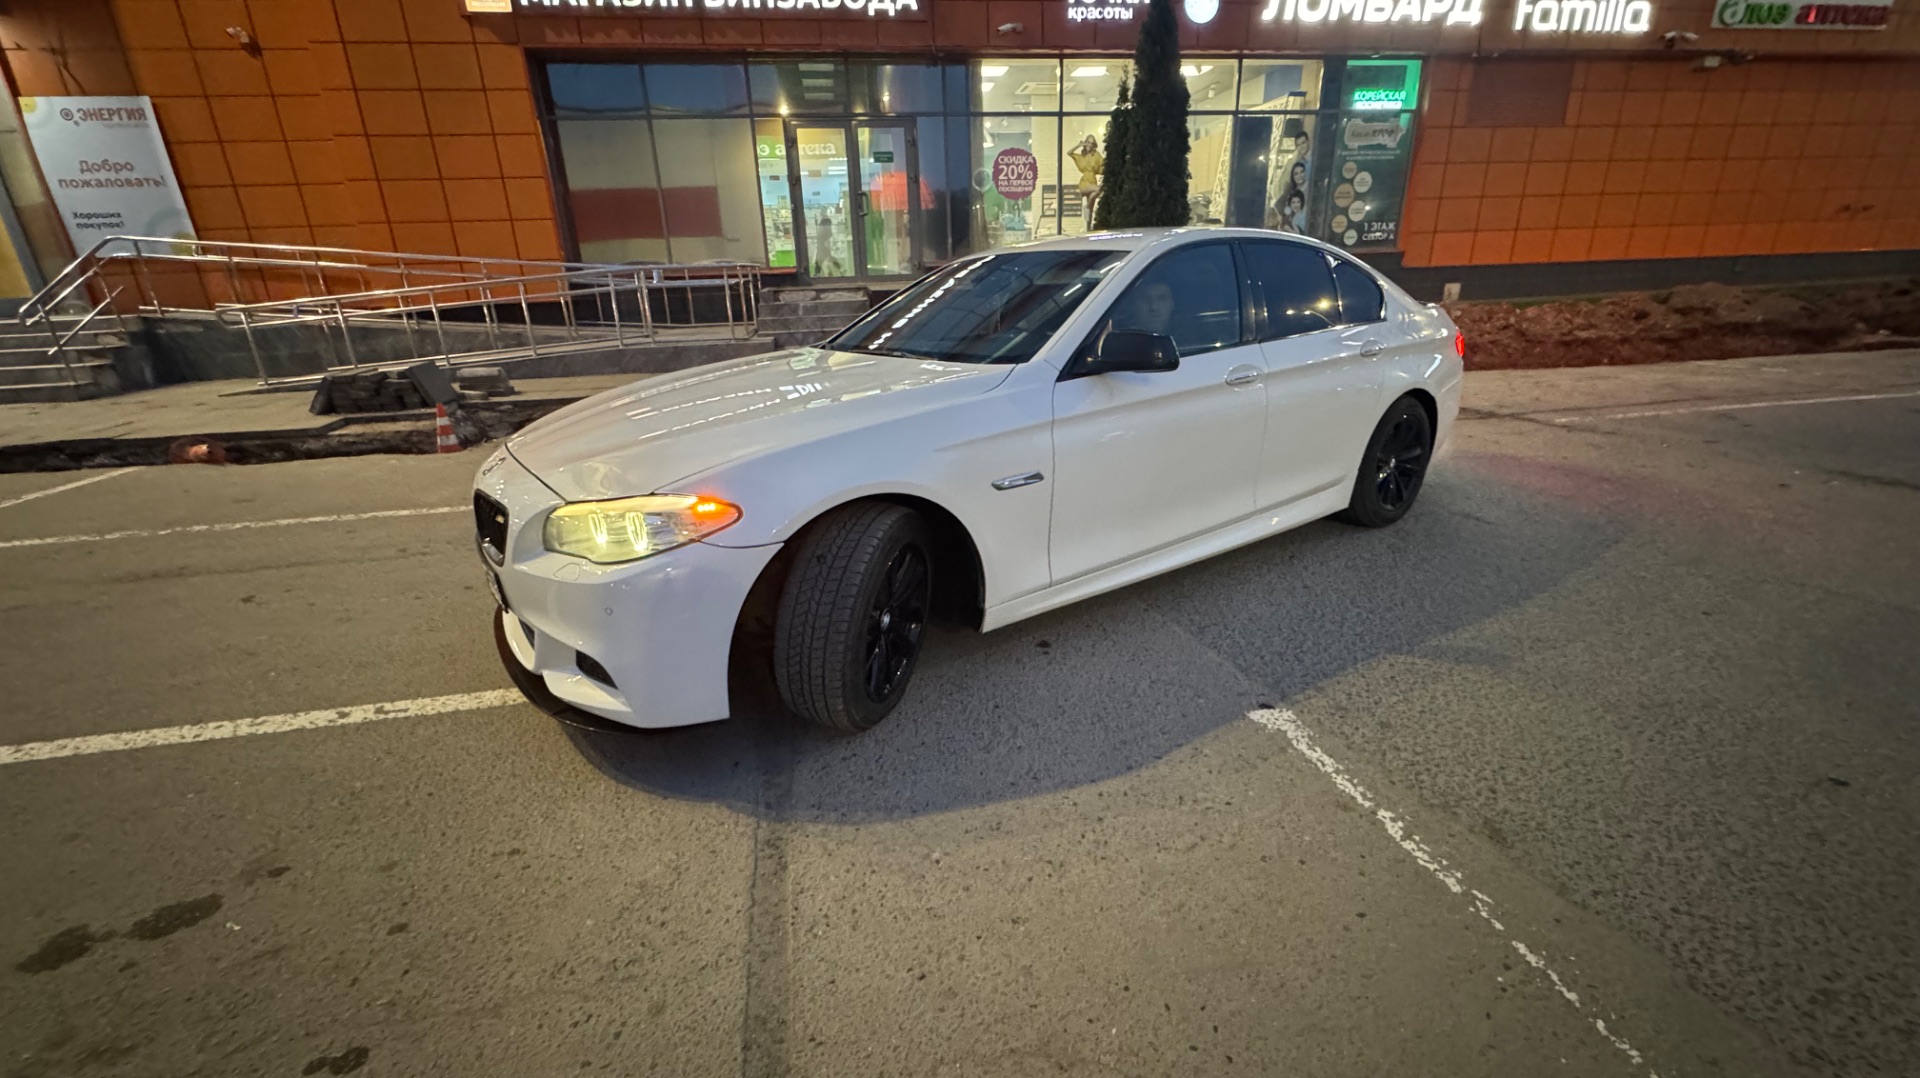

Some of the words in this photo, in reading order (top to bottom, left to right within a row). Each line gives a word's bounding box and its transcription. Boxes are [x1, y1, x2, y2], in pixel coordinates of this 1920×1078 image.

[1067, 6, 1134, 22] красоты
[1261, 0, 1482, 26] ЛОМБАРД
[1353, 88, 1407, 101] КОРЕЙСКАЯ
[77, 107, 147, 121] ЭНЕРГИЯ
[998, 155, 1034, 164] СКИДКА
[79, 158, 134, 174] Добро
[998, 164, 1033, 180] 20%
[58, 176, 166, 188] пожаловать!
[998, 179, 1009, 187] НА
[1009, 179, 1034, 187] ПЕРВОЕ
[72, 212, 121, 220] Хороших
[1370, 222, 1396, 231] ЭТАЖ
[1362, 233, 1388, 241] СЕКТОР
